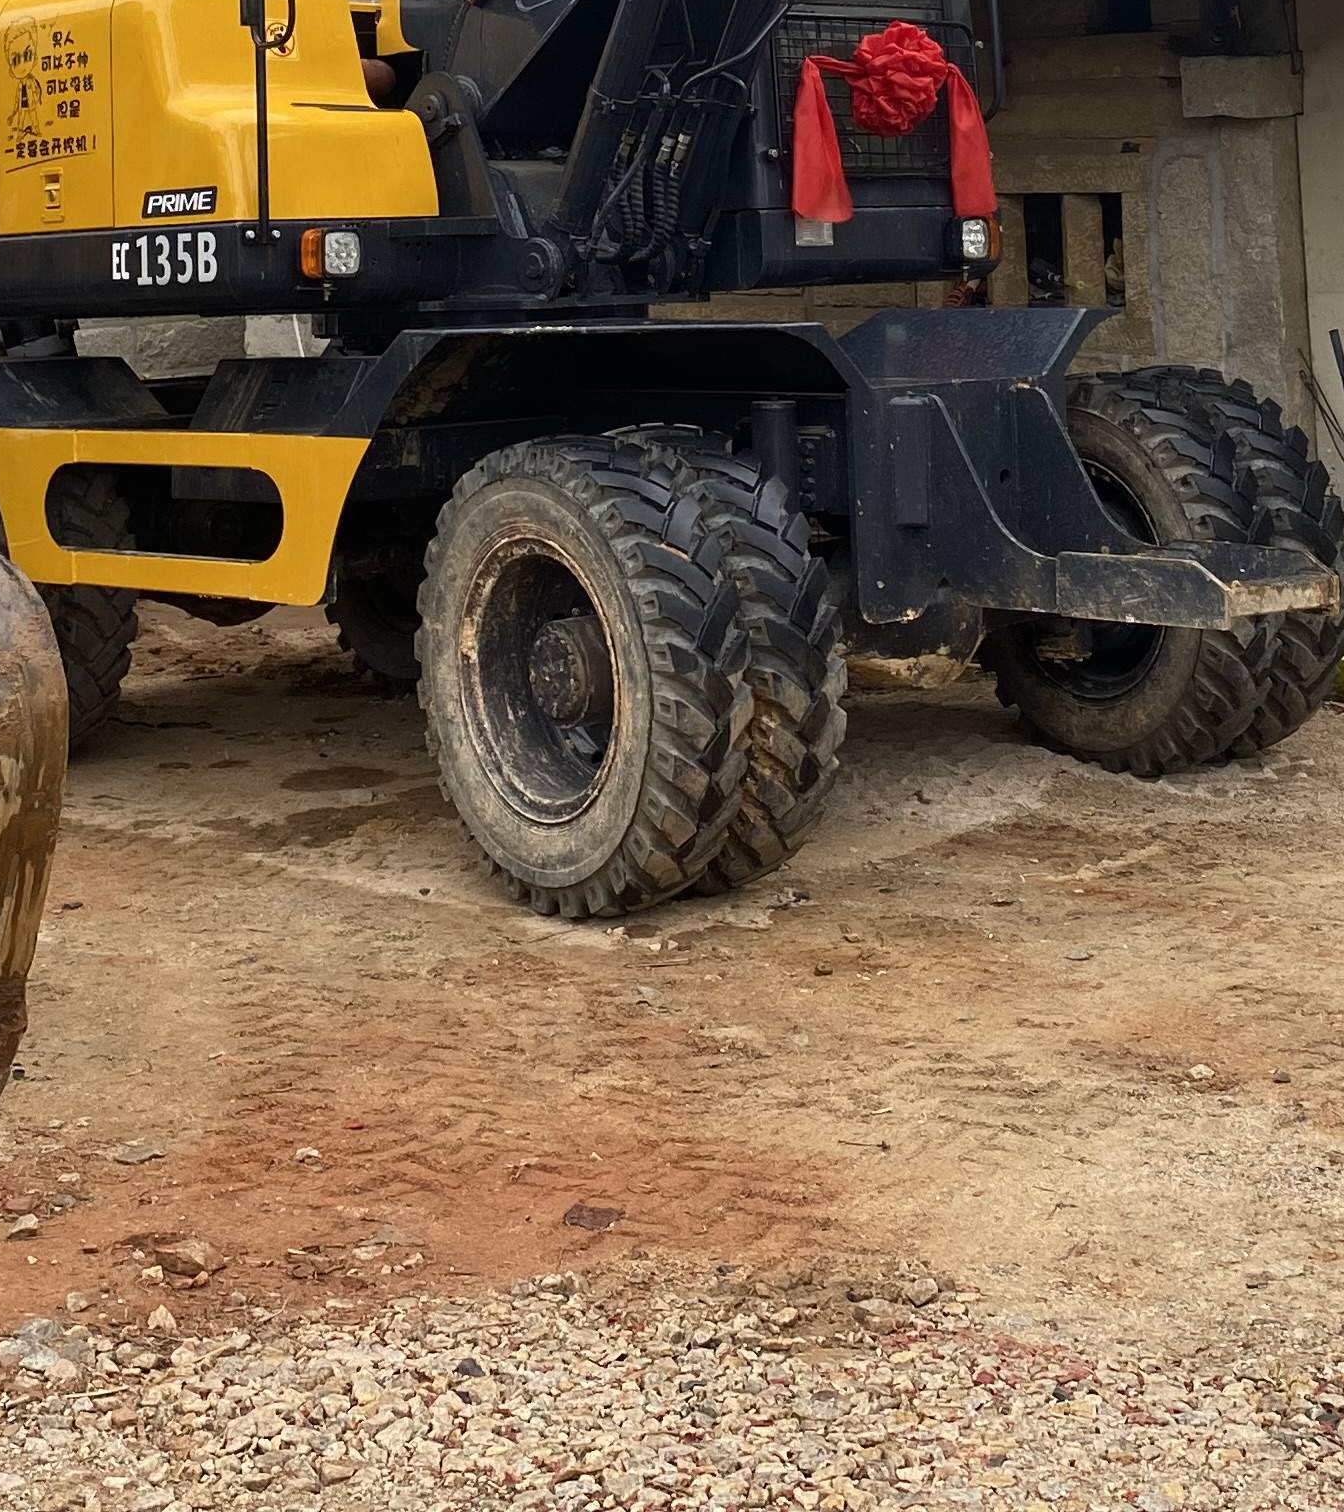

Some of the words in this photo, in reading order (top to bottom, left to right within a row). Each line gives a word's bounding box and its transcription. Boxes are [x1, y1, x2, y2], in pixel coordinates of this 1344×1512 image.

[52, 31, 74, 48] 男人
[46, 74, 94, 96] 可以没钱
[57, 99, 81, 118] 但是
[146, 190, 213, 215] PRIME
